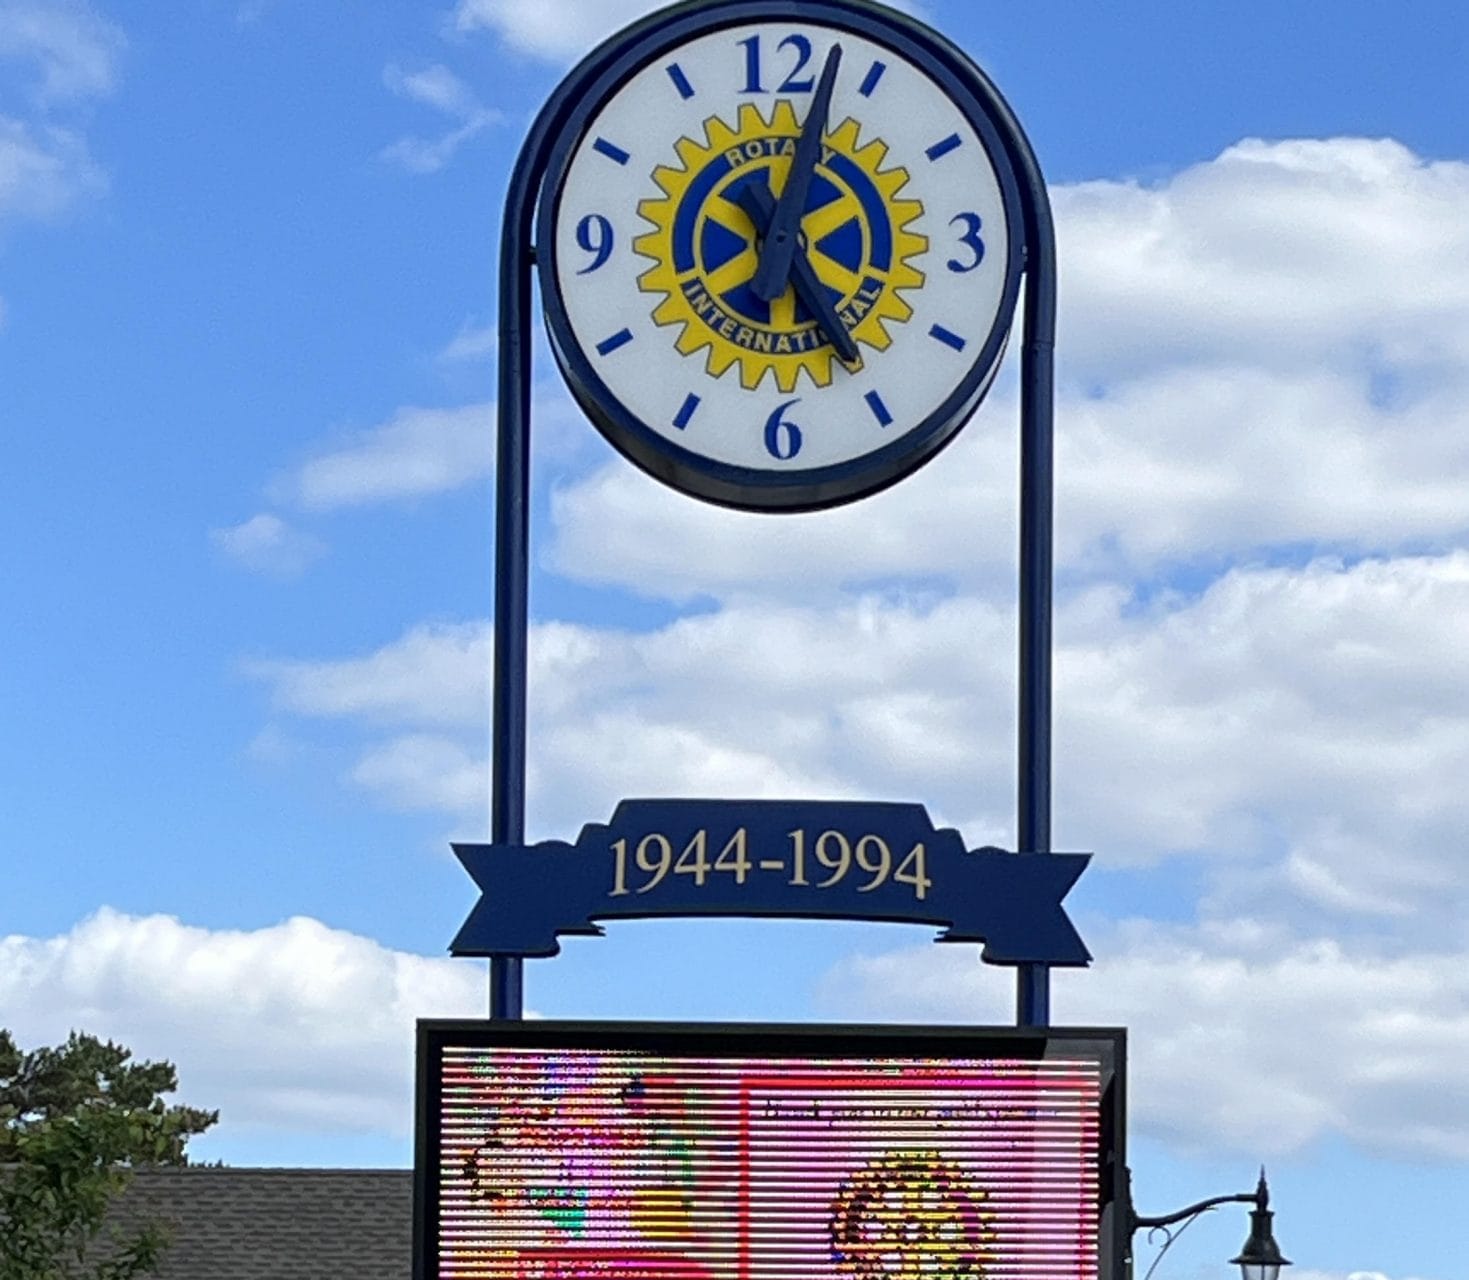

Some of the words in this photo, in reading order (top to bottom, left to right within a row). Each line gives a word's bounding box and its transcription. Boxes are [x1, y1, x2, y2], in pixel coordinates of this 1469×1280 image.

[736, 34, 816, 94] 12
[724, 138, 837, 169] ROTAY
[575, 214, 615, 275] 9
[946, 212, 986, 273] 3
[685, 277, 884, 353] INTERNATINAL
[763, 399, 803, 460] 6
[607, 828, 932, 900] 1944-1994
